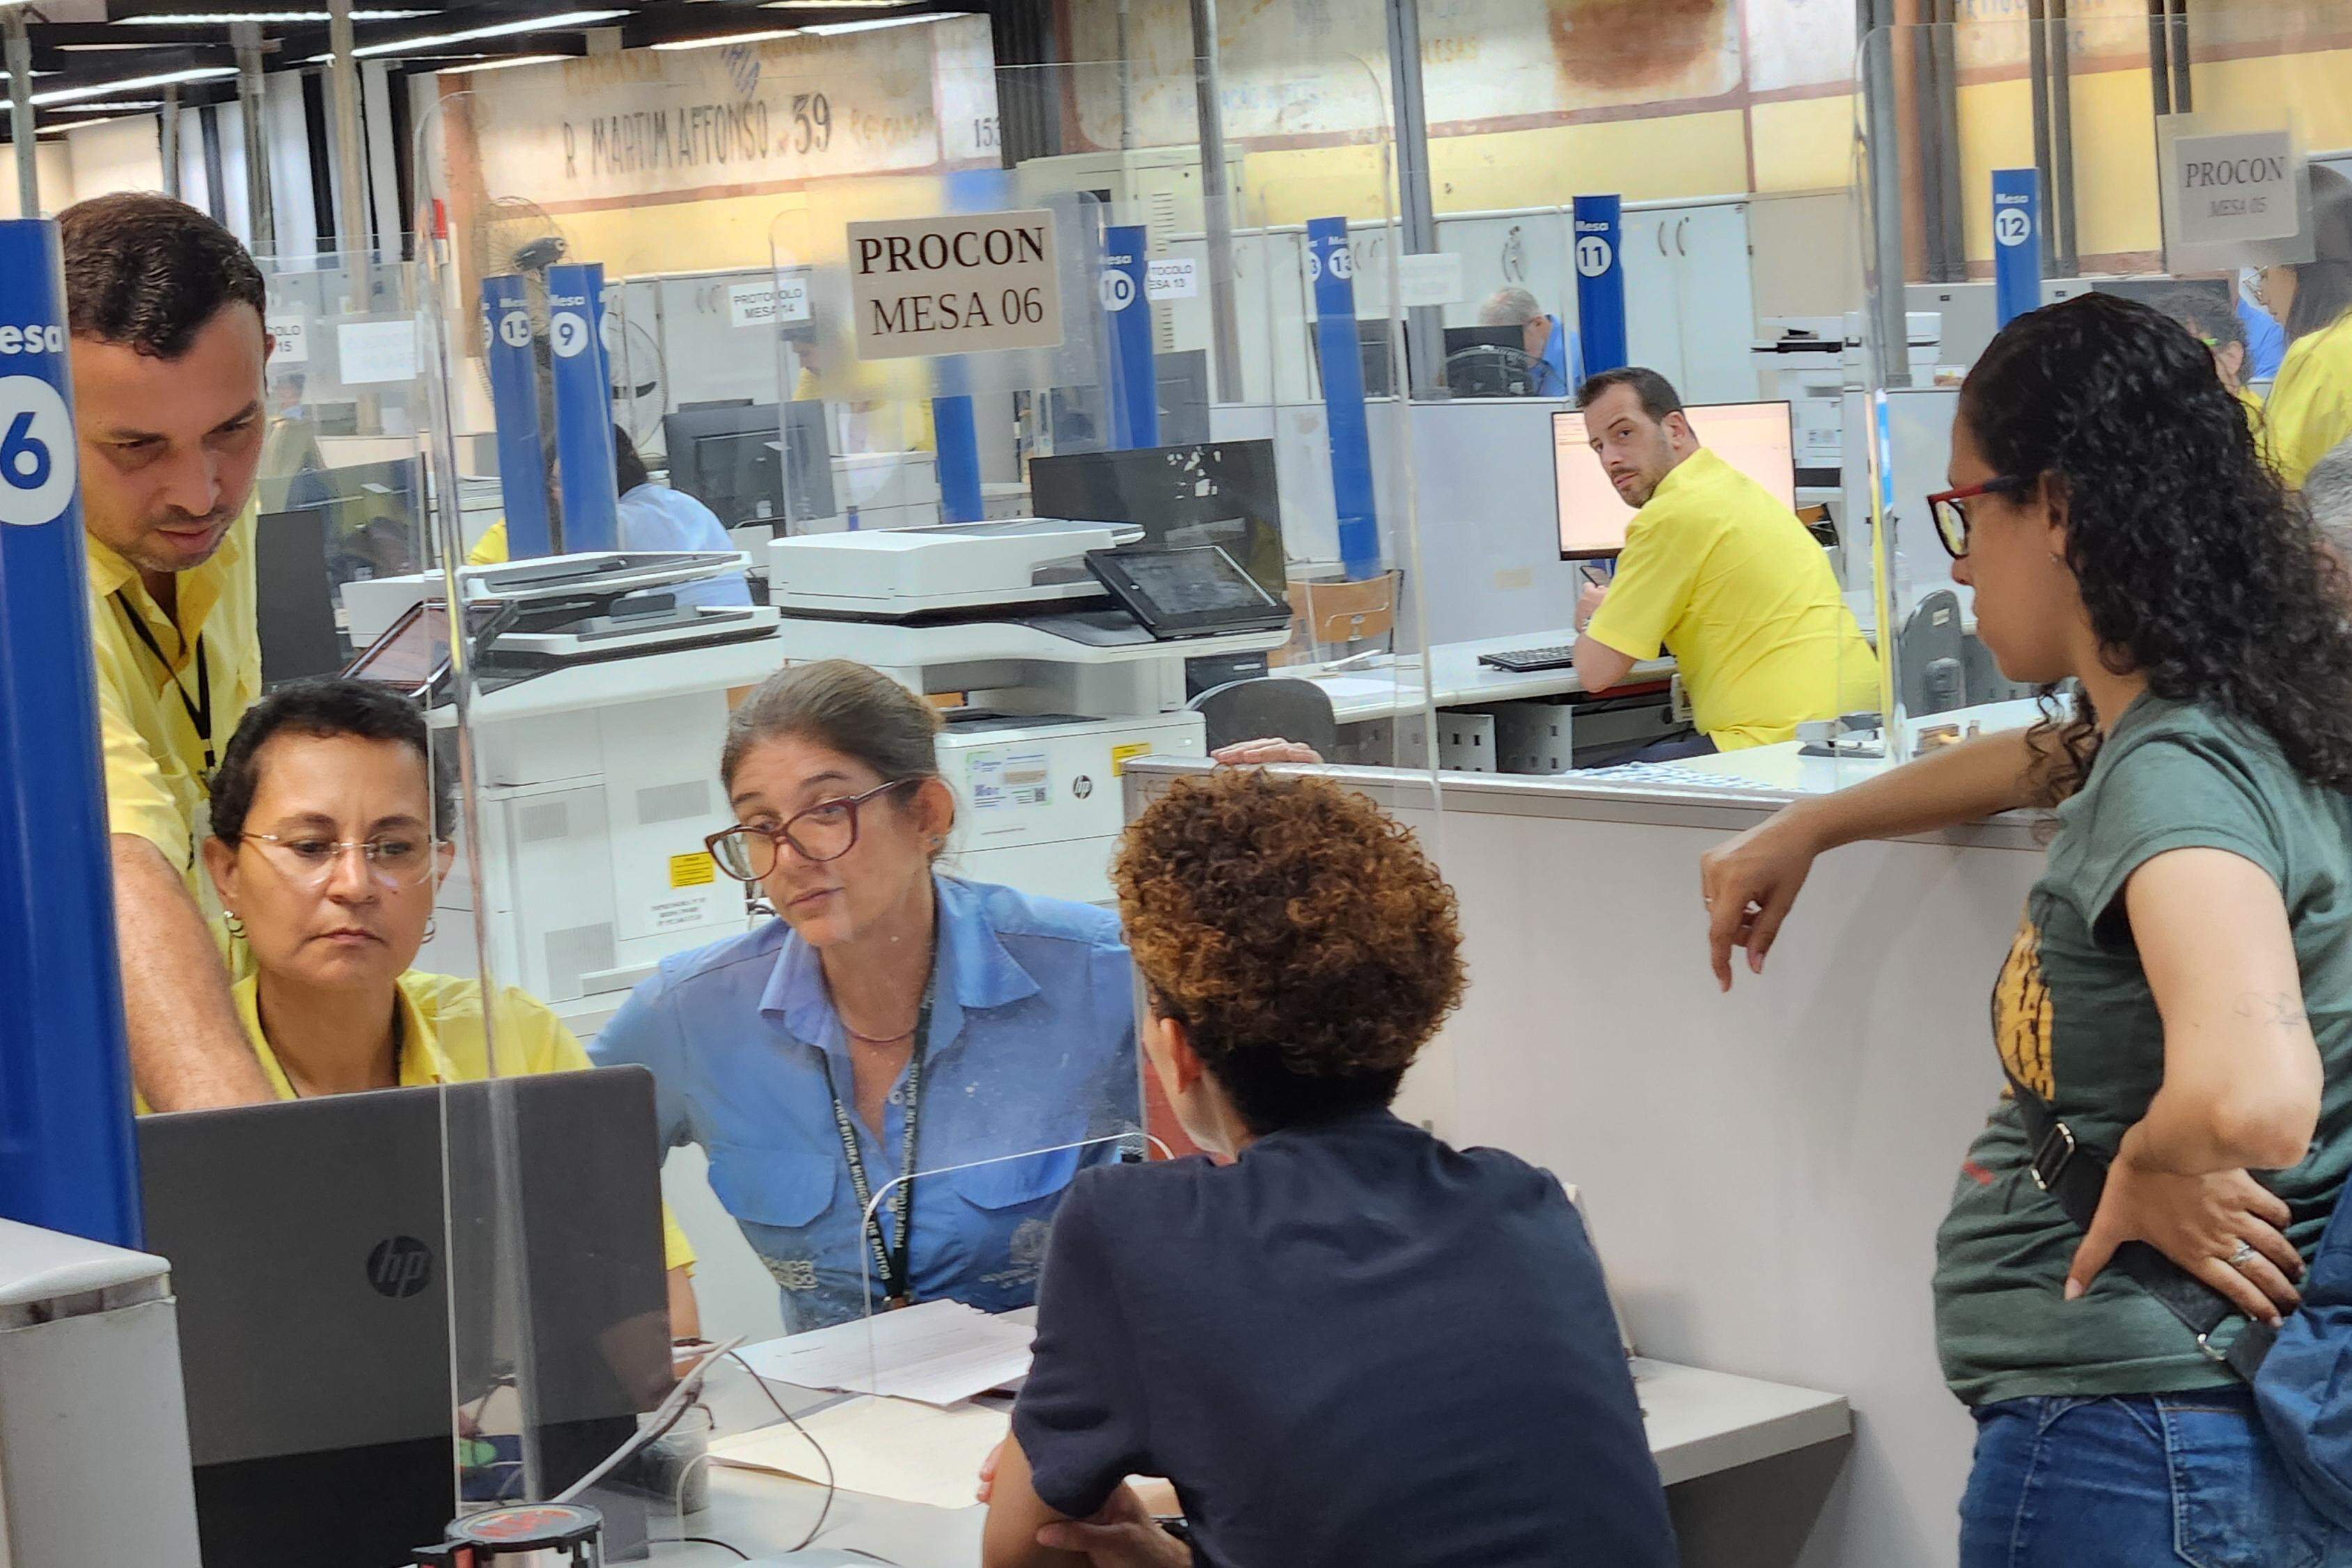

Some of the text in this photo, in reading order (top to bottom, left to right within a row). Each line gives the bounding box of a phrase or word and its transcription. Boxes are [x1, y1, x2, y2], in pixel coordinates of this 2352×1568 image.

[563, 121, 576, 178] R
[678, 99, 769, 168] AFFONSO
[792, 93, 830, 154] 39
[2185, 156, 2286, 188] PROCON
[2000, 217, 2025, 237] 12
[854, 226, 1045, 274] PROCON
[1581, 246, 1603, 267] 11
[1147, 279, 1170, 290] ESA
[1150, 265, 1193, 276] TOCOLO
[870, 287, 1043, 336] MESA 06
[0, 324, 63, 355] esa
[558, 322, 574, 346] 9
[0, 411, 51, 489] 6
[1074, 775, 1091, 799] hp
[849, 1163, 872, 1215] MUNICIPA
[373, 1237, 430, 1297] hp
